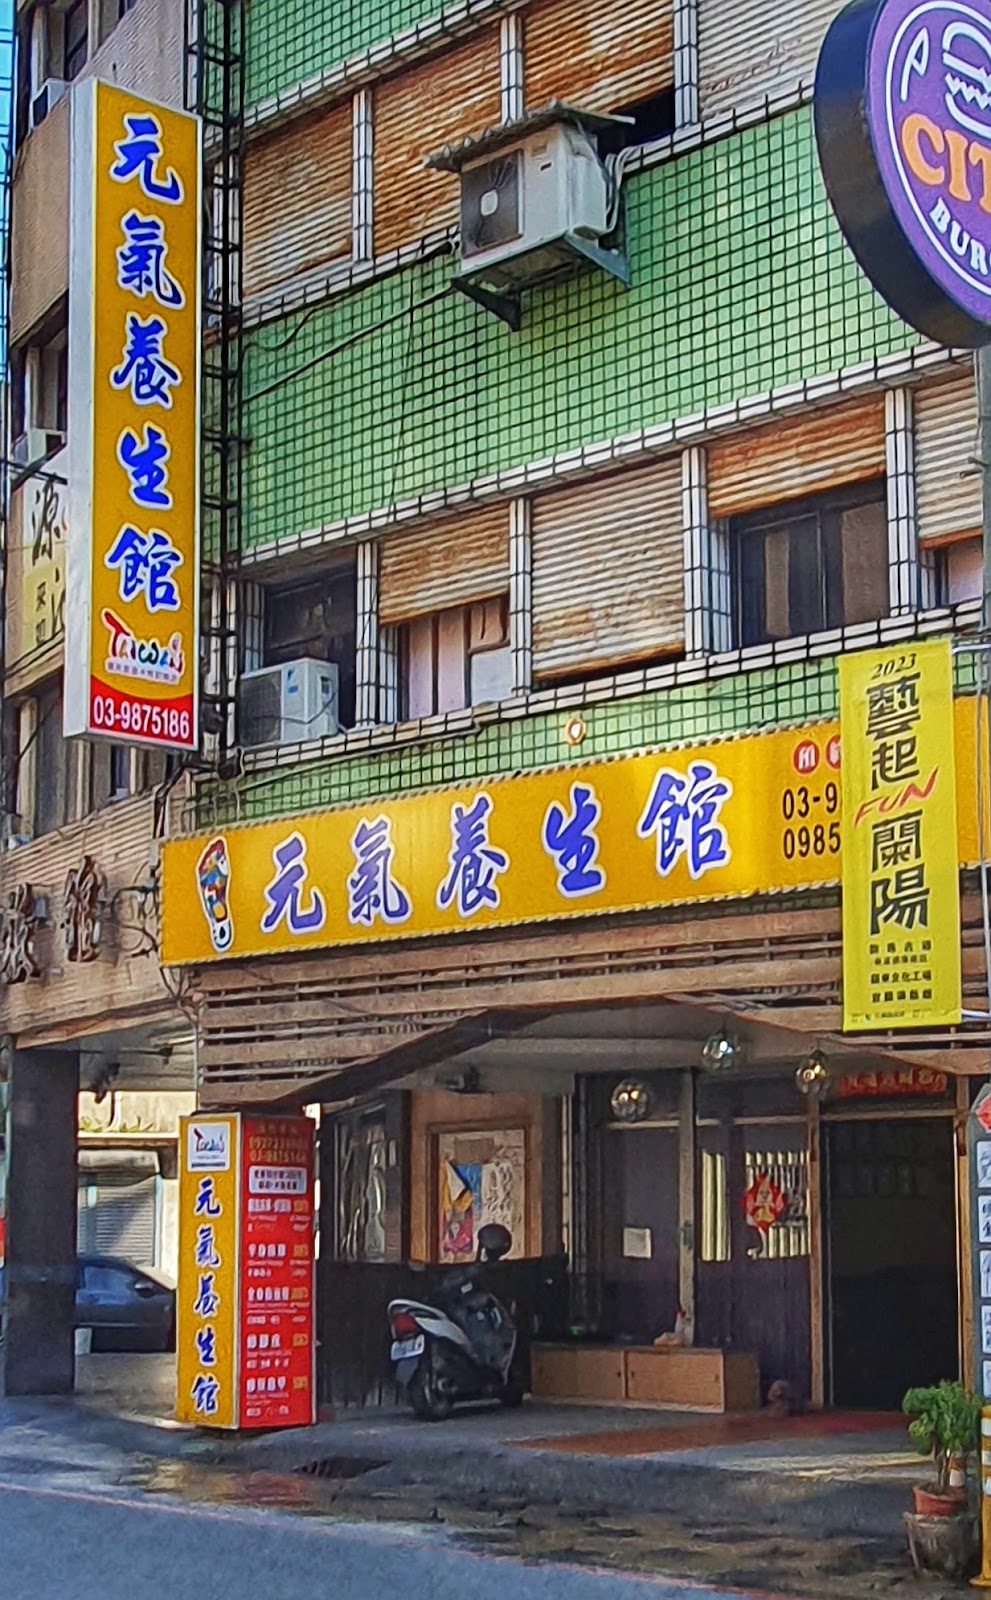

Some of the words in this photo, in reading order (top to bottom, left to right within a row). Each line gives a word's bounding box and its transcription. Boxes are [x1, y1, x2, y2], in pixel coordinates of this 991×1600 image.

[929, 197, 991, 275] BUR
[106, 114, 185, 611] 元氣養生館
[870, 652, 918, 680] 2023
[93, 694, 190, 740] 03-9875186
[853, 765, 939, 830] FUN
[260, 763, 732, 932] 元氣養生館
[193, 1176, 221, 1415] 元氣養生館
